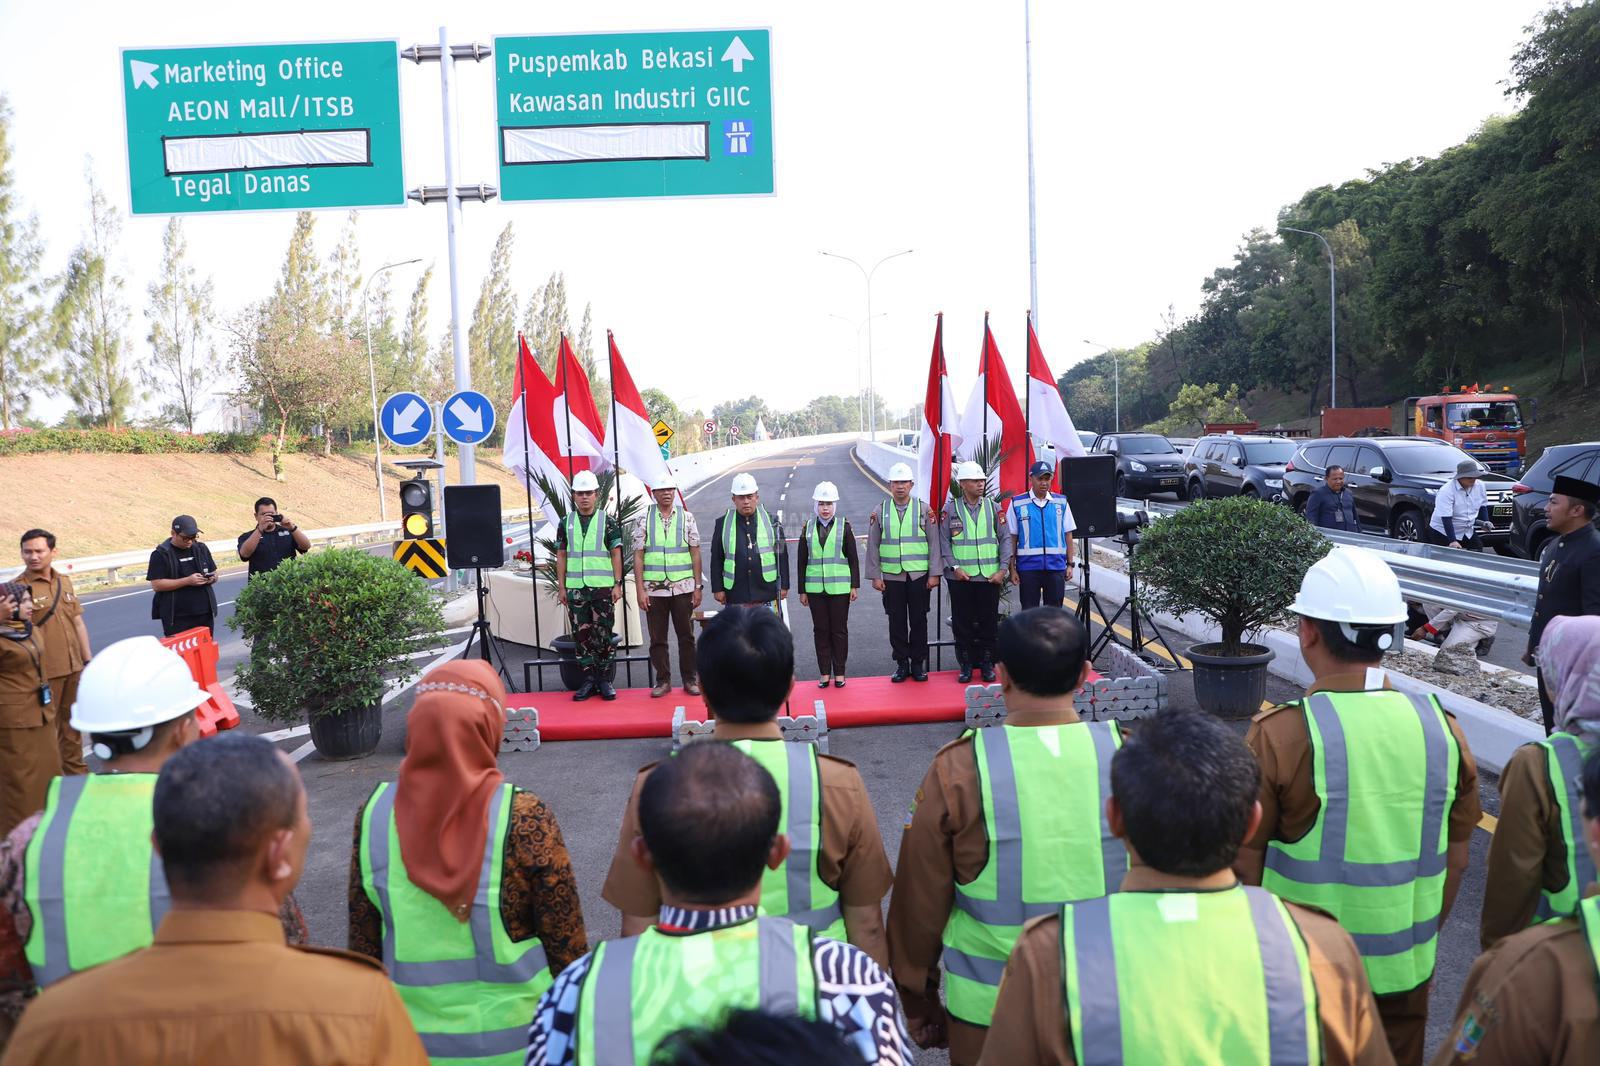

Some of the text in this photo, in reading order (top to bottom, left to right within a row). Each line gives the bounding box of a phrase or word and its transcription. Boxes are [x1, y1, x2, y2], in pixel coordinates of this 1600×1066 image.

[164, 57, 343, 86] Marketing Office
[508, 47, 712, 77] Puspemkab Bekasi
[167, 95, 354, 121] AEON Mall/ITSB
[509, 86, 750, 112] Kawasan Industri GIIC
[172, 174, 311, 202] Tegal Danas
